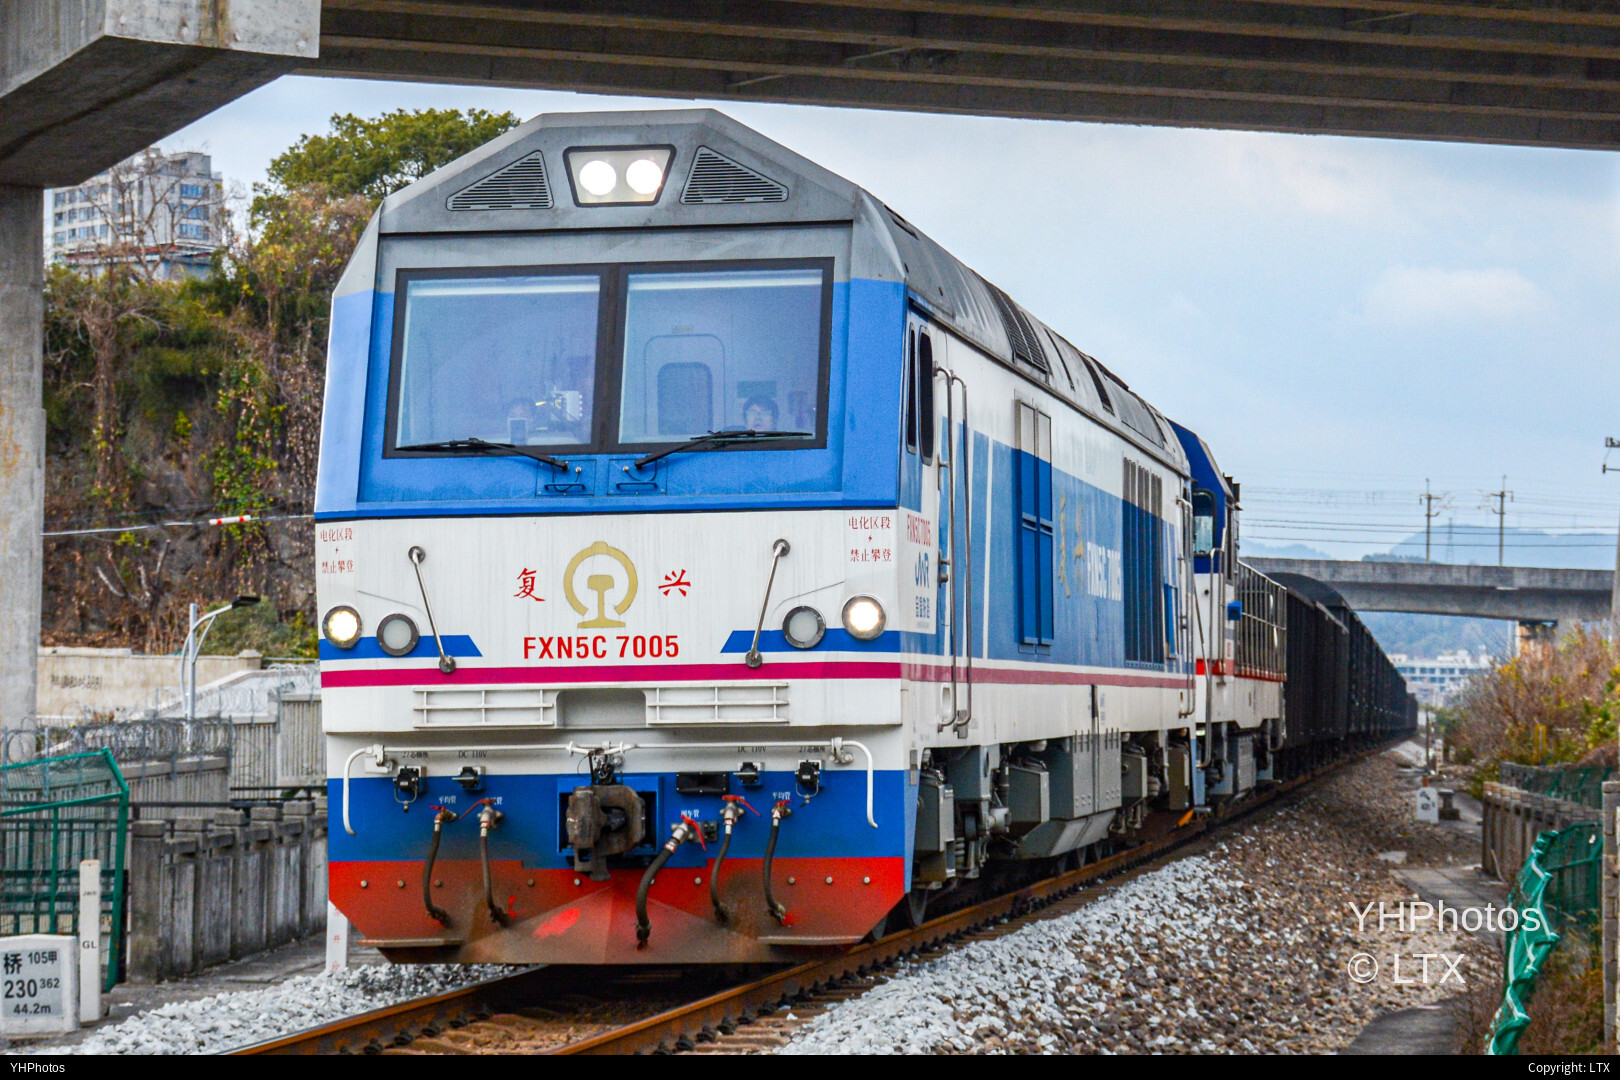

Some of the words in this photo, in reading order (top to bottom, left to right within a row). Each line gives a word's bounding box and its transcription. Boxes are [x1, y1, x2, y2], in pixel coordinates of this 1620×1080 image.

[848, 516, 891, 530] 电化区段
[320, 527, 353, 543] 电化区段
[850, 548, 892, 562] 禁止攀登
[321, 559, 354, 574] 禁止攀登
[513, 567, 546, 602] 复
[658, 568, 691, 597] 兴
[523, 635, 607, 659] FXN5C
[616, 635, 679, 659] 7005
[458, 751, 467, 759] DC
[472, 750, 488, 759] 110V
[82, 940, 97, 949] GL
[3, 953, 23, 975] 桥
[4, 978, 38, 999] 230
[39, 978, 60, 989] 362
[13, 1002, 52, 1015] 44.2m
